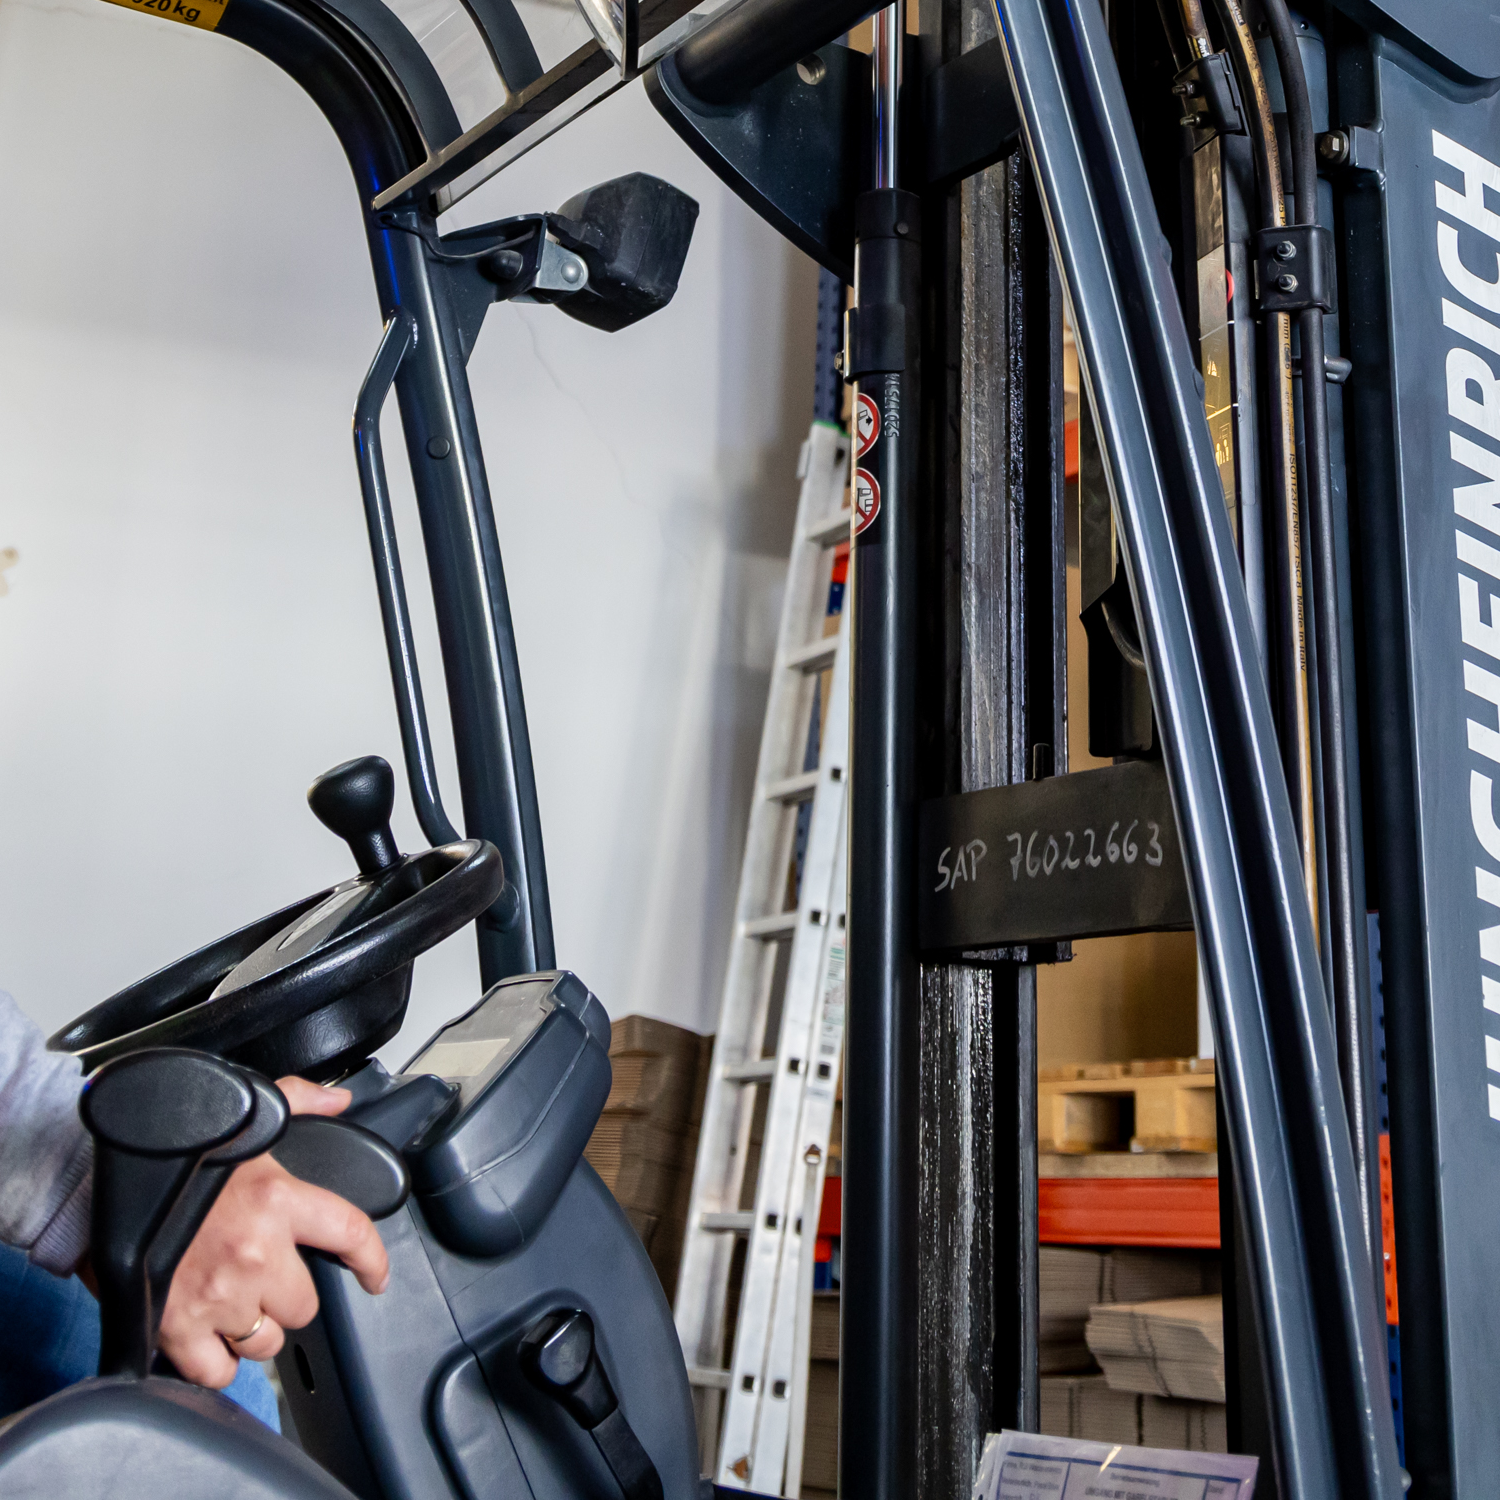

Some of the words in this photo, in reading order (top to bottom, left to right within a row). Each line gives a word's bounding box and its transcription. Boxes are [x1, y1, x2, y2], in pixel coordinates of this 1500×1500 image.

[172, 0, 201, 22] kg
[934, 838, 988, 893] SAP
[1006, 819, 1164, 882] 76022663
